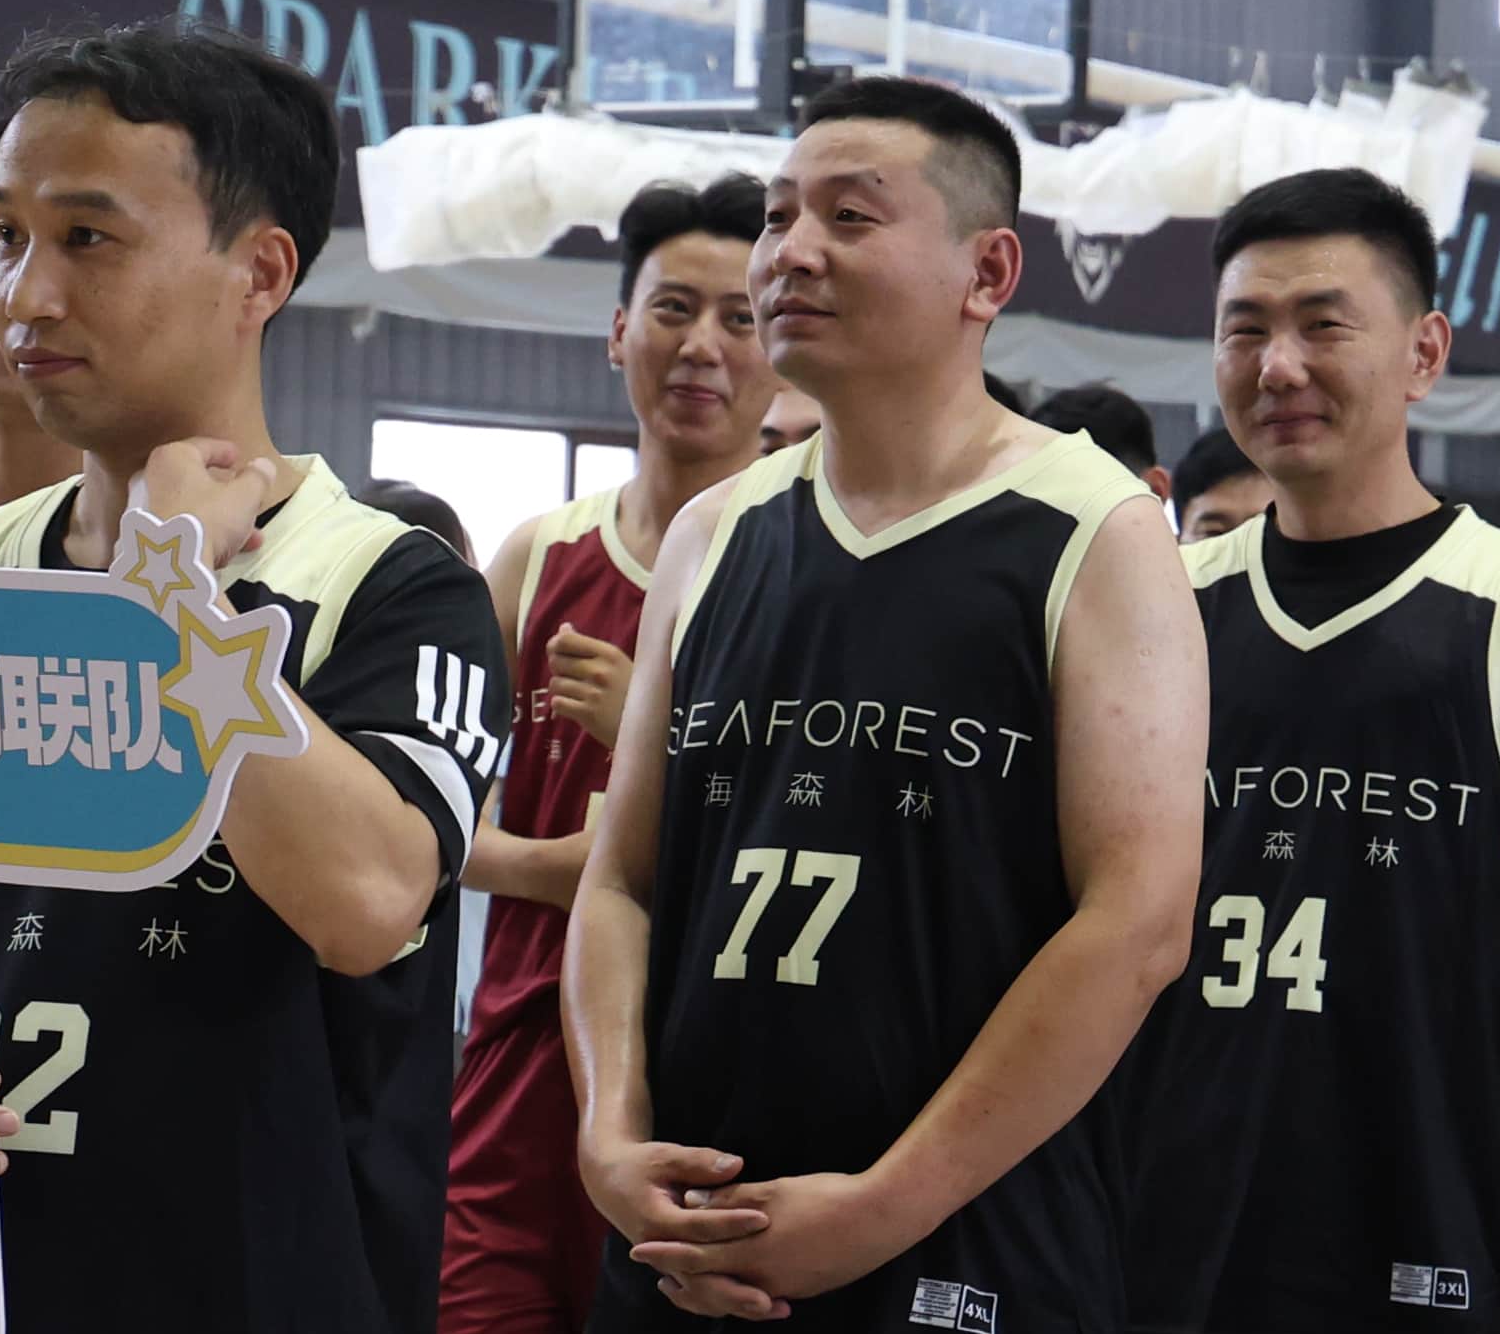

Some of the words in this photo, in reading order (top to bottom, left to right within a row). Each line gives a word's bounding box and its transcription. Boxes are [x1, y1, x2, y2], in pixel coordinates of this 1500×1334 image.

[668, 699, 1033, 779] SEAFOREST
[713, 848, 861, 986] 77
[1202, 895, 1327, 1013] 34
[964, 1302, 991, 1324] 4XL
[1437, 1282, 1465, 1297] 3XL
